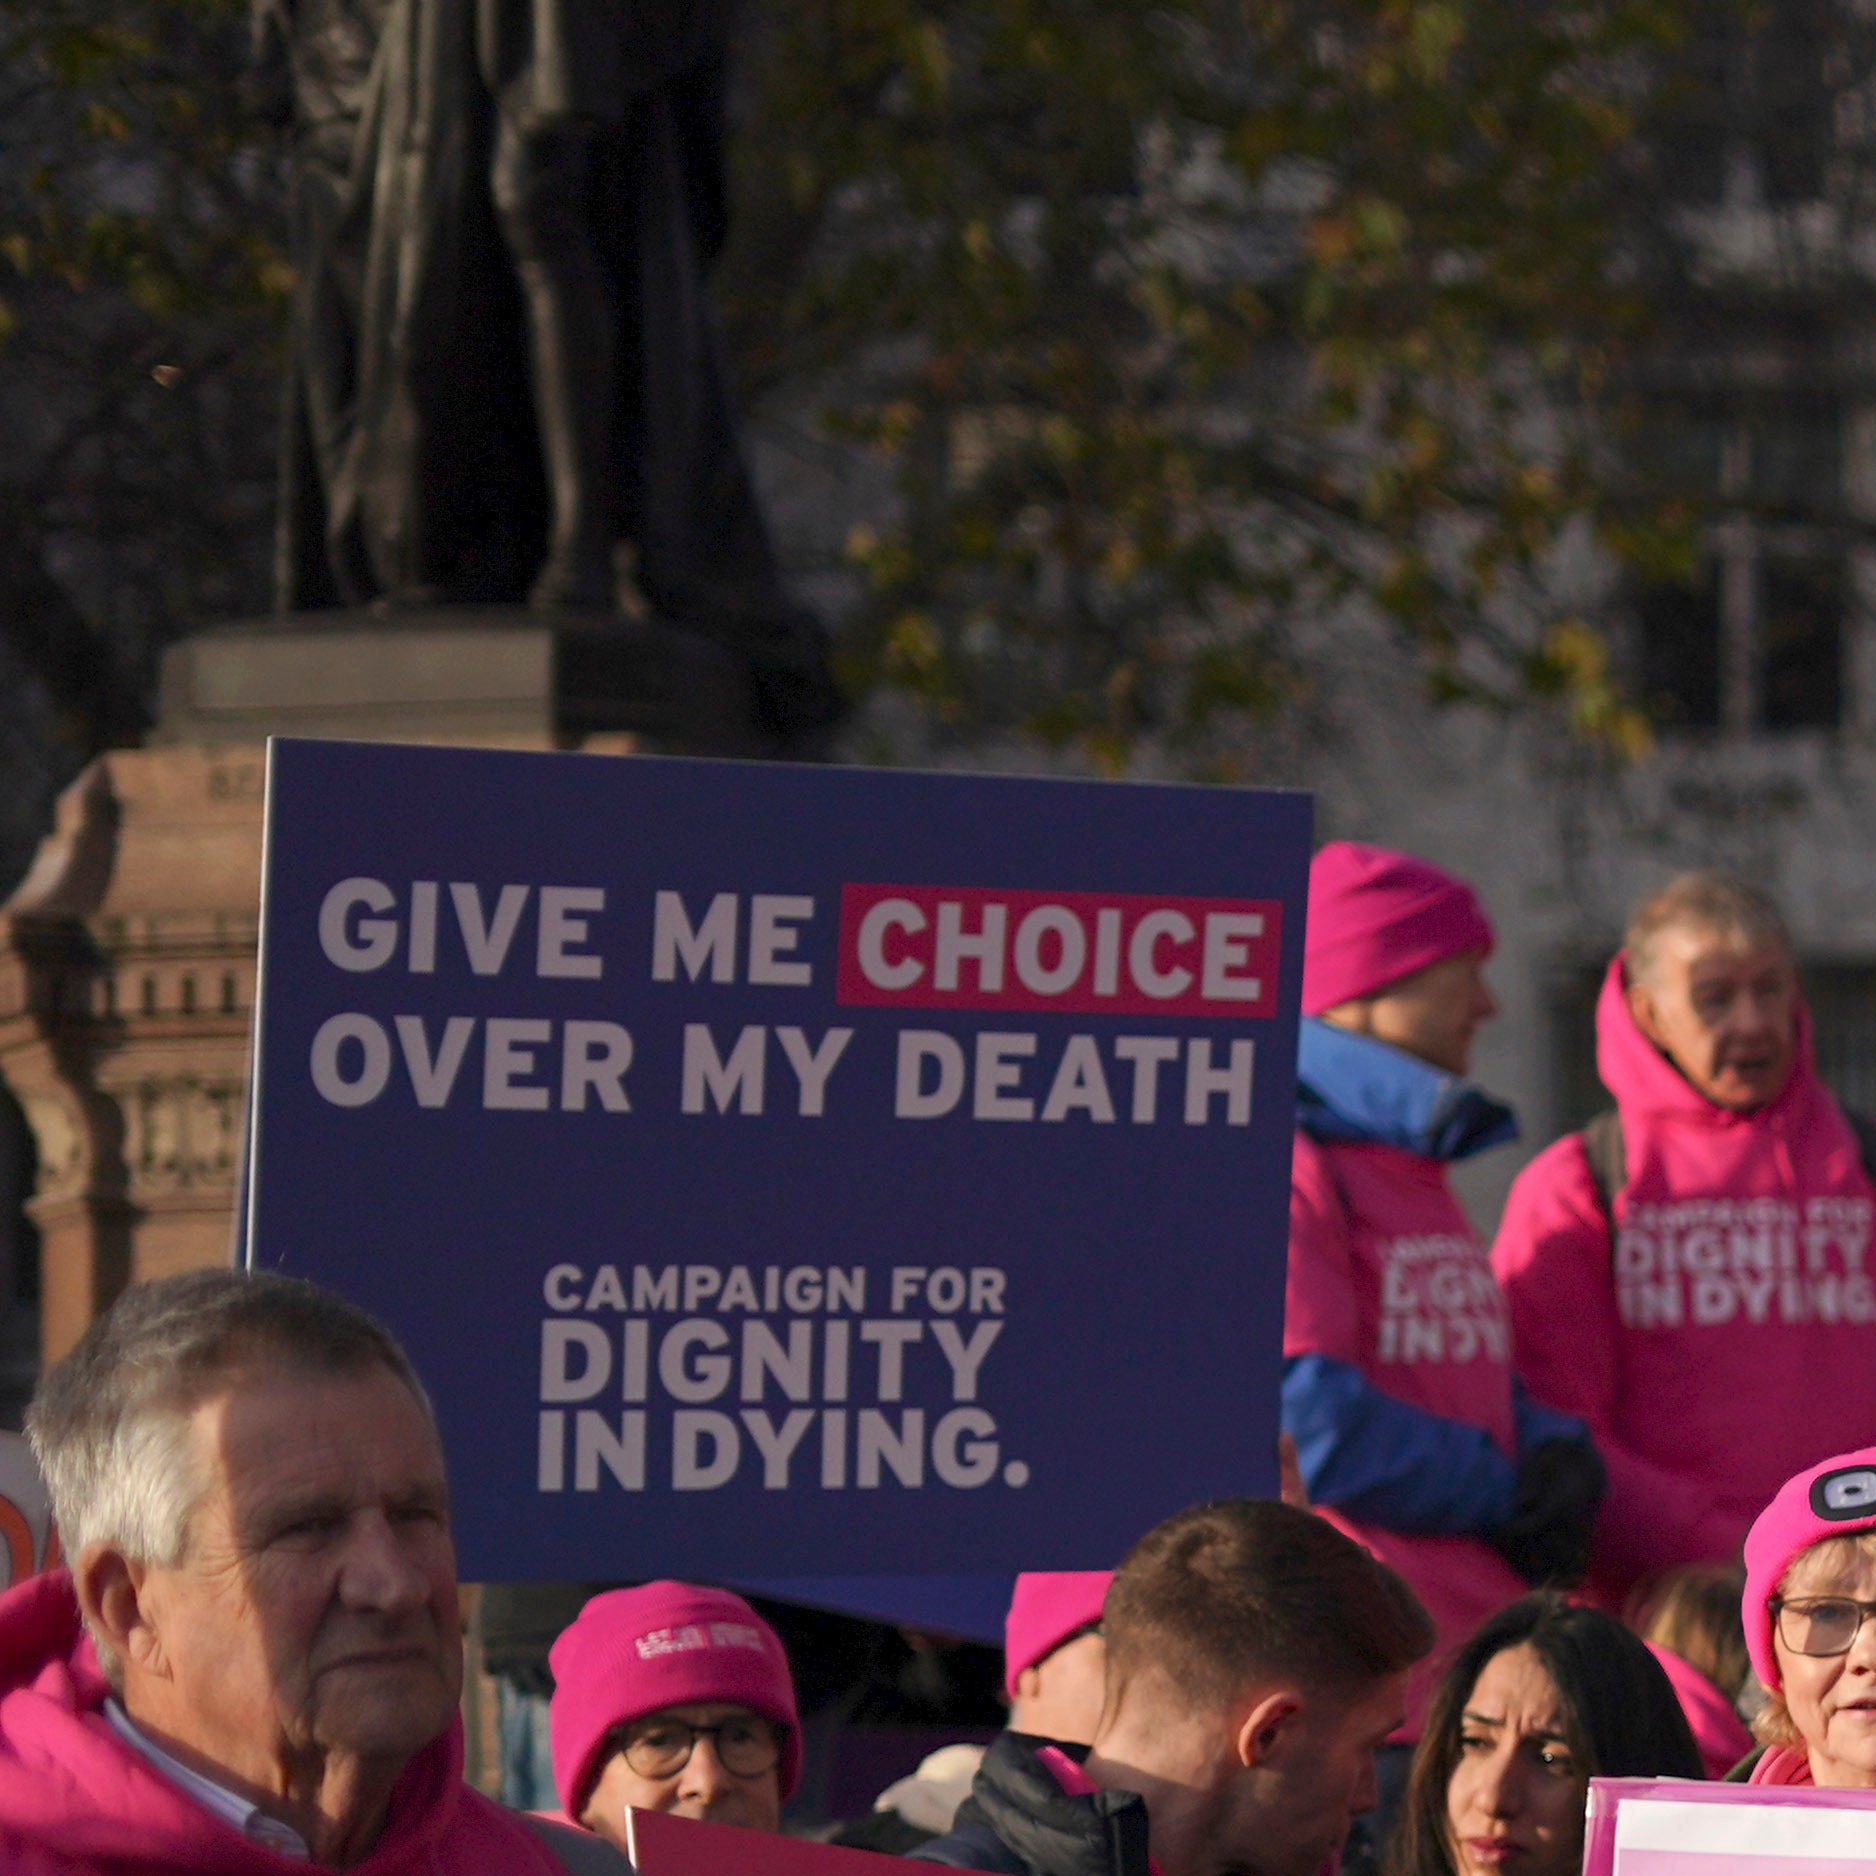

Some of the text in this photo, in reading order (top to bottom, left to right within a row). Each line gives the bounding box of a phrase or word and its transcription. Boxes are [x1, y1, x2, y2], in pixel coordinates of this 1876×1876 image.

[318, 878, 1264, 1000] GIVE ME CHOICE
[311, 1013, 1256, 1125] OVER MY DEATH
[543, 1263, 1007, 1315] CAMPAIGN FOR
[1617, 1226, 1869, 1273] DIGNITY
[539, 1319, 1004, 1402] DIGNITY
[538, 1409, 1029, 1491] IN DYING.
